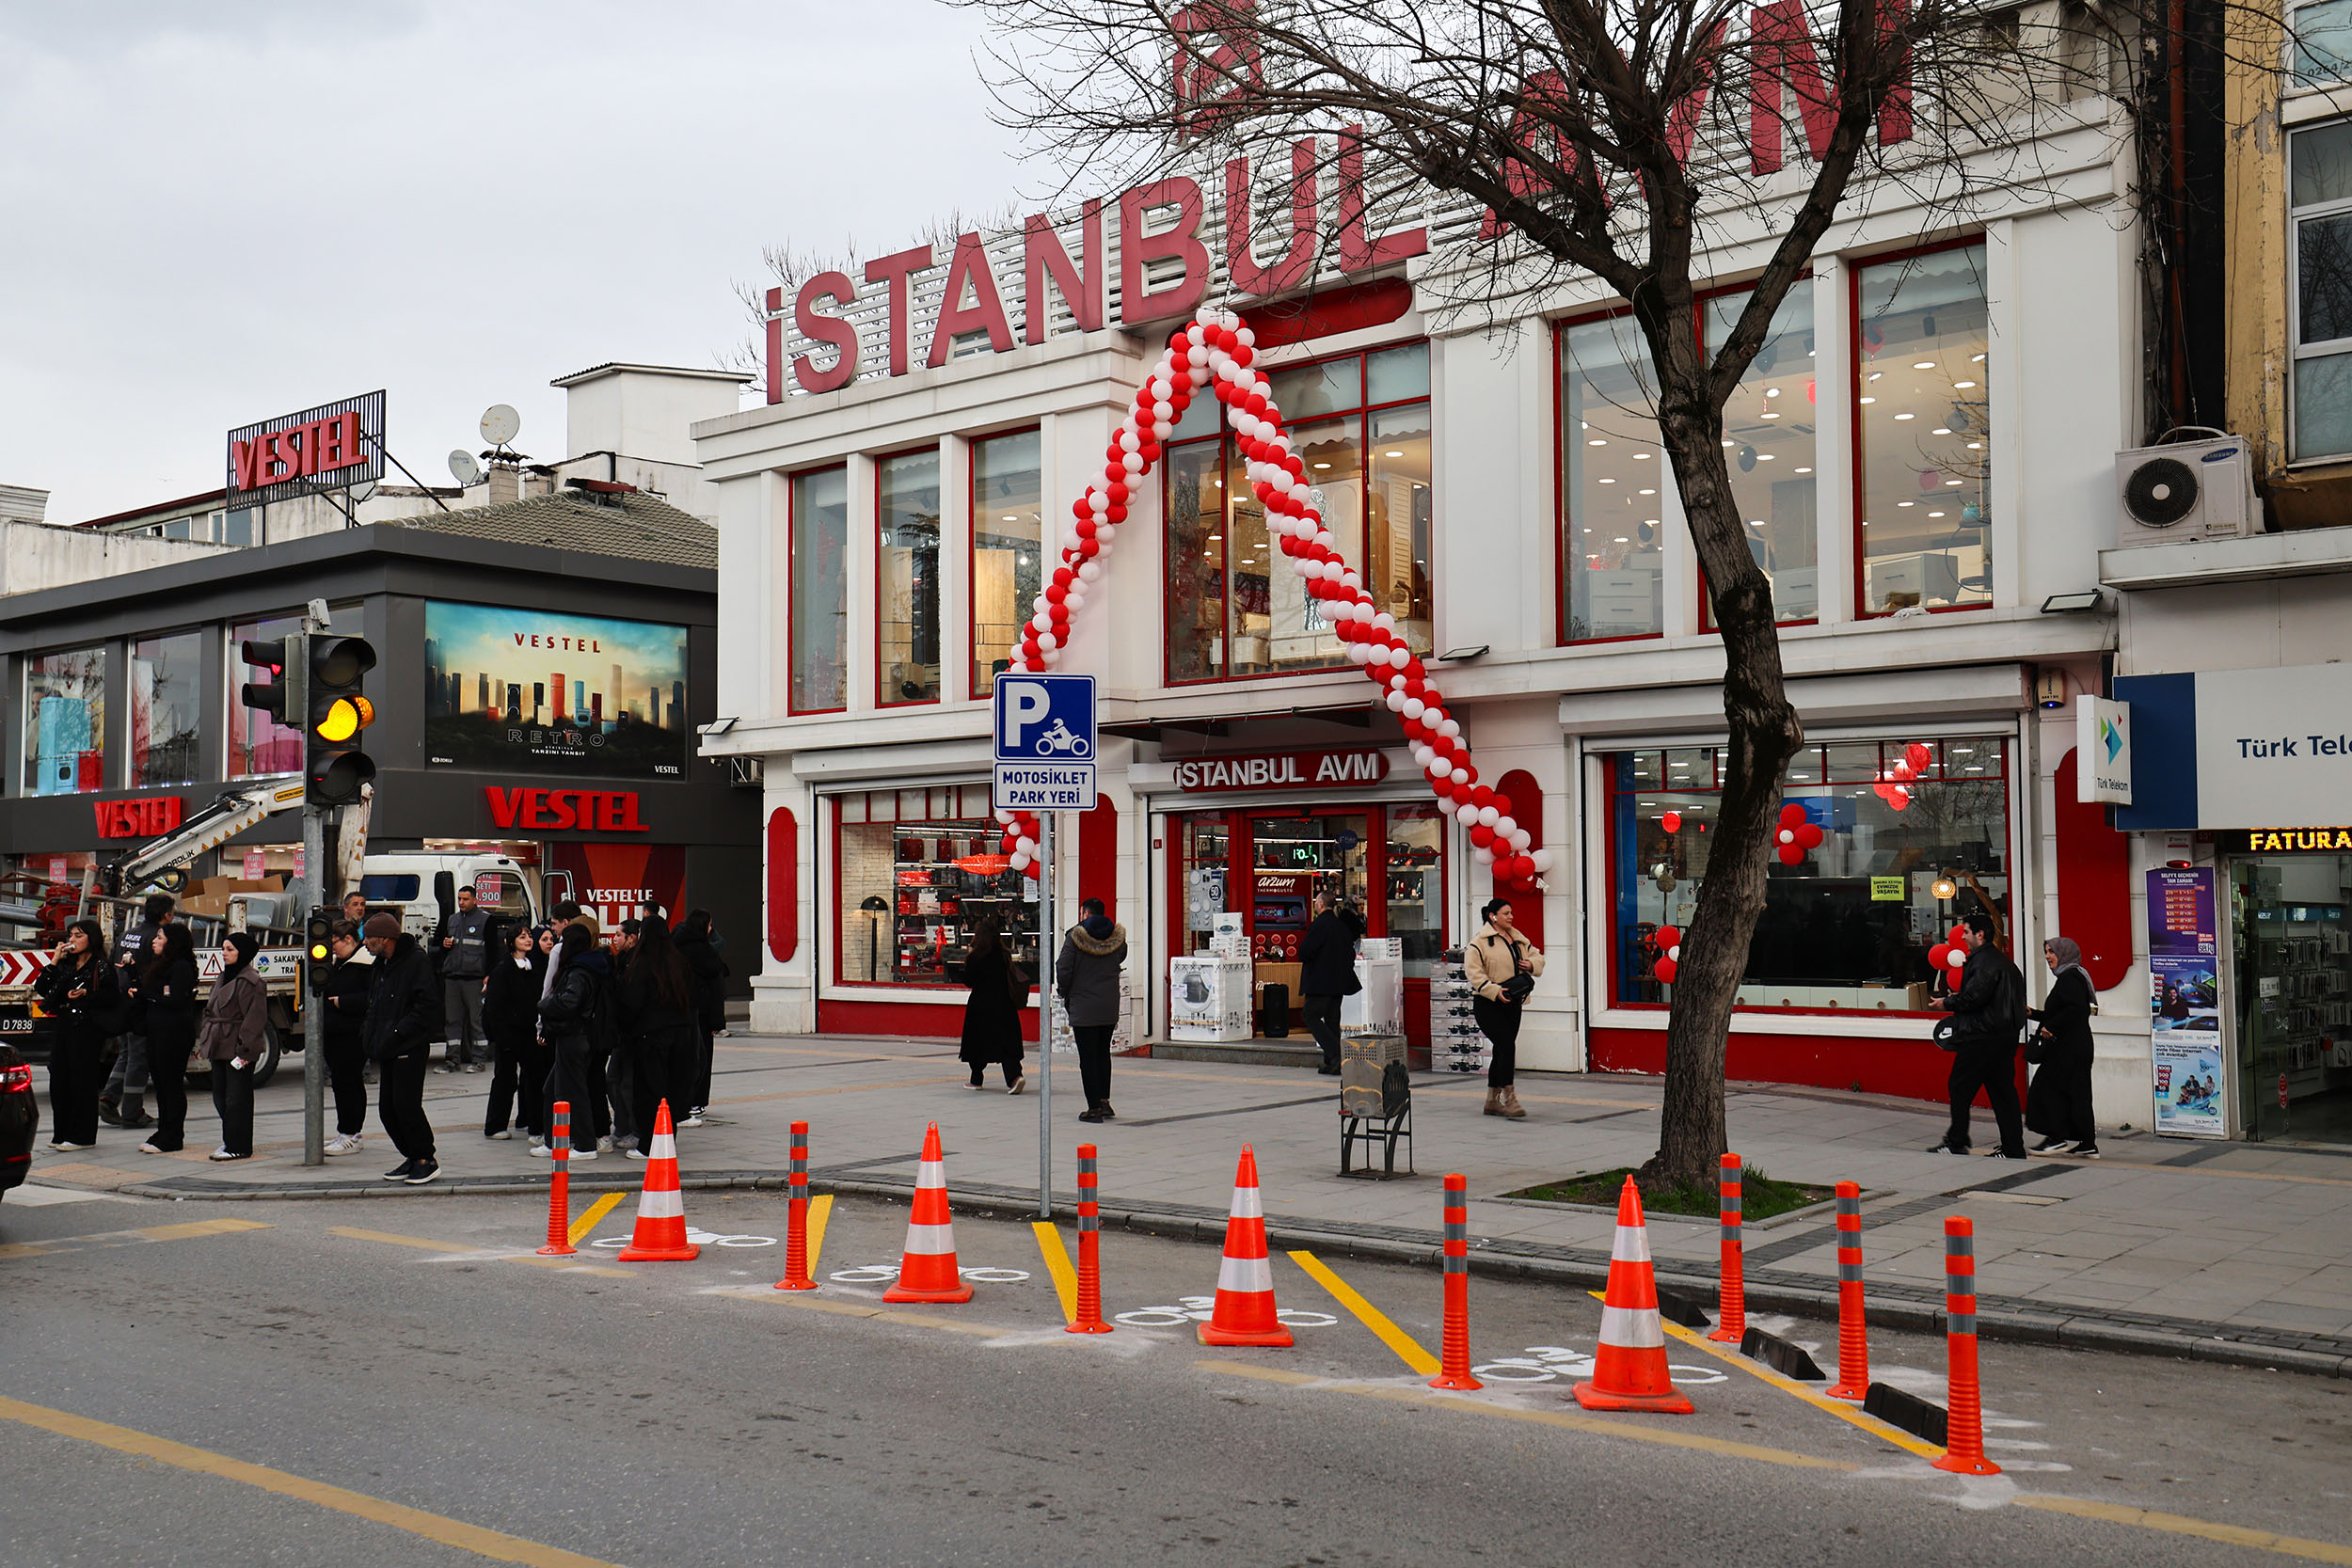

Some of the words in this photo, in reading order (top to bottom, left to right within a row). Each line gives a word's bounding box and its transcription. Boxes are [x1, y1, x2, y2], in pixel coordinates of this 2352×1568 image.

[232, 411, 369, 491] VESTEL
[514, 633, 601, 654] VESTEL
[1005, 682, 1051, 747] P
[508, 728, 605, 748] RETRO
[2236, 736, 2297, 758] Türk
[2307, 734, 2352, 756] Tel
[654, 765, 680, 774] VESTEL
[1003, 768, 1088, 784] MOTOSİKLET
[1315, 752, 1379, 782] AVM
[2097, 777, 2107, 789] Türk
[2108, 778, 2129, 791] Telekom
[1009, 790, 1046, 804] PARK
[1050, 787, 1080, 804] YERİ
[485, 786, 650, 832] VESTEL
[2250, 831, 2352, 850] FATURA
[1257, 877, 1296, 888] arzum
[586, 888, 654, 902] VESTEL'LE
[273, 954, 305, 964] SAKARYA
[12, 1019, 33, 1030] 7838
